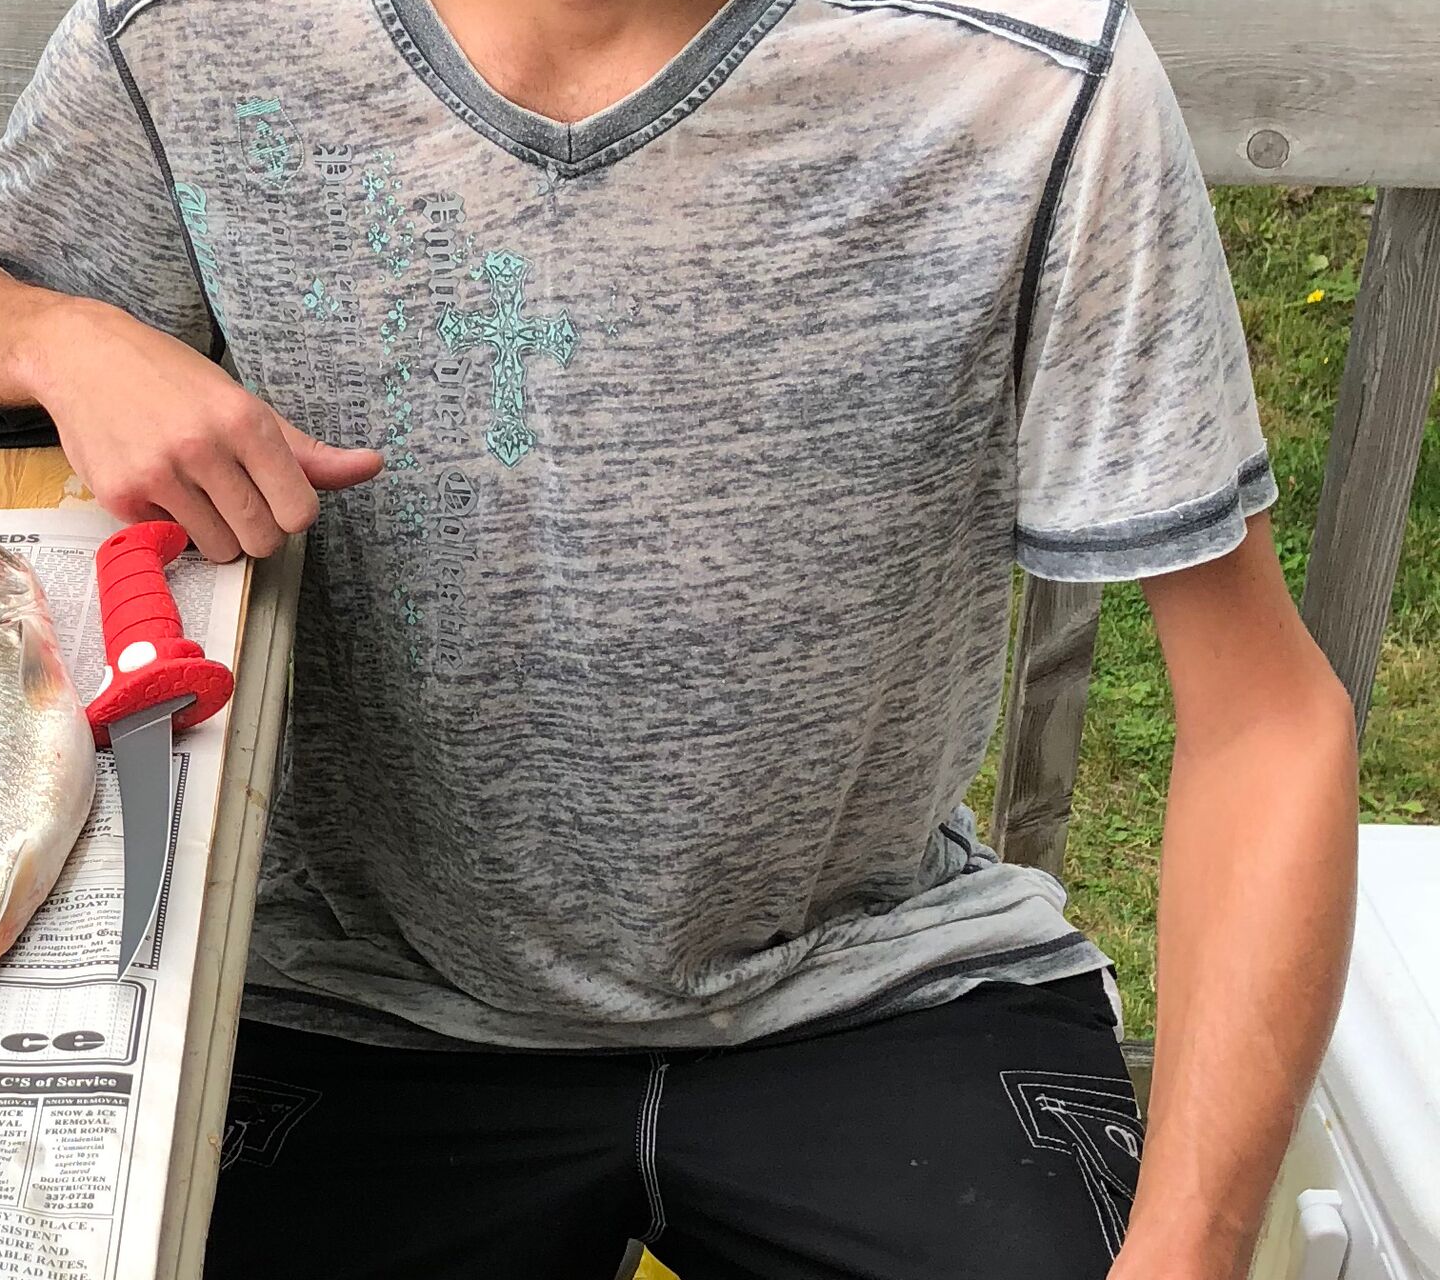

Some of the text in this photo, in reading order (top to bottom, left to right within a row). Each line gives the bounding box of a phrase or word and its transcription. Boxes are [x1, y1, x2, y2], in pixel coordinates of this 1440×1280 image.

[50, 547, 85, 555] Legals
[35, 1077, 53, 1088] of
[57, 1076, 117, 1087] Service
[97, 1109, 116, 1117] ICE
[32, 1183, 111, 1192] CONSTRUCTION
[15, 1213, 35, 1226] TO
[38, 1243, 69, 1257] AND
[23, 1266, 44, 1277] AD
